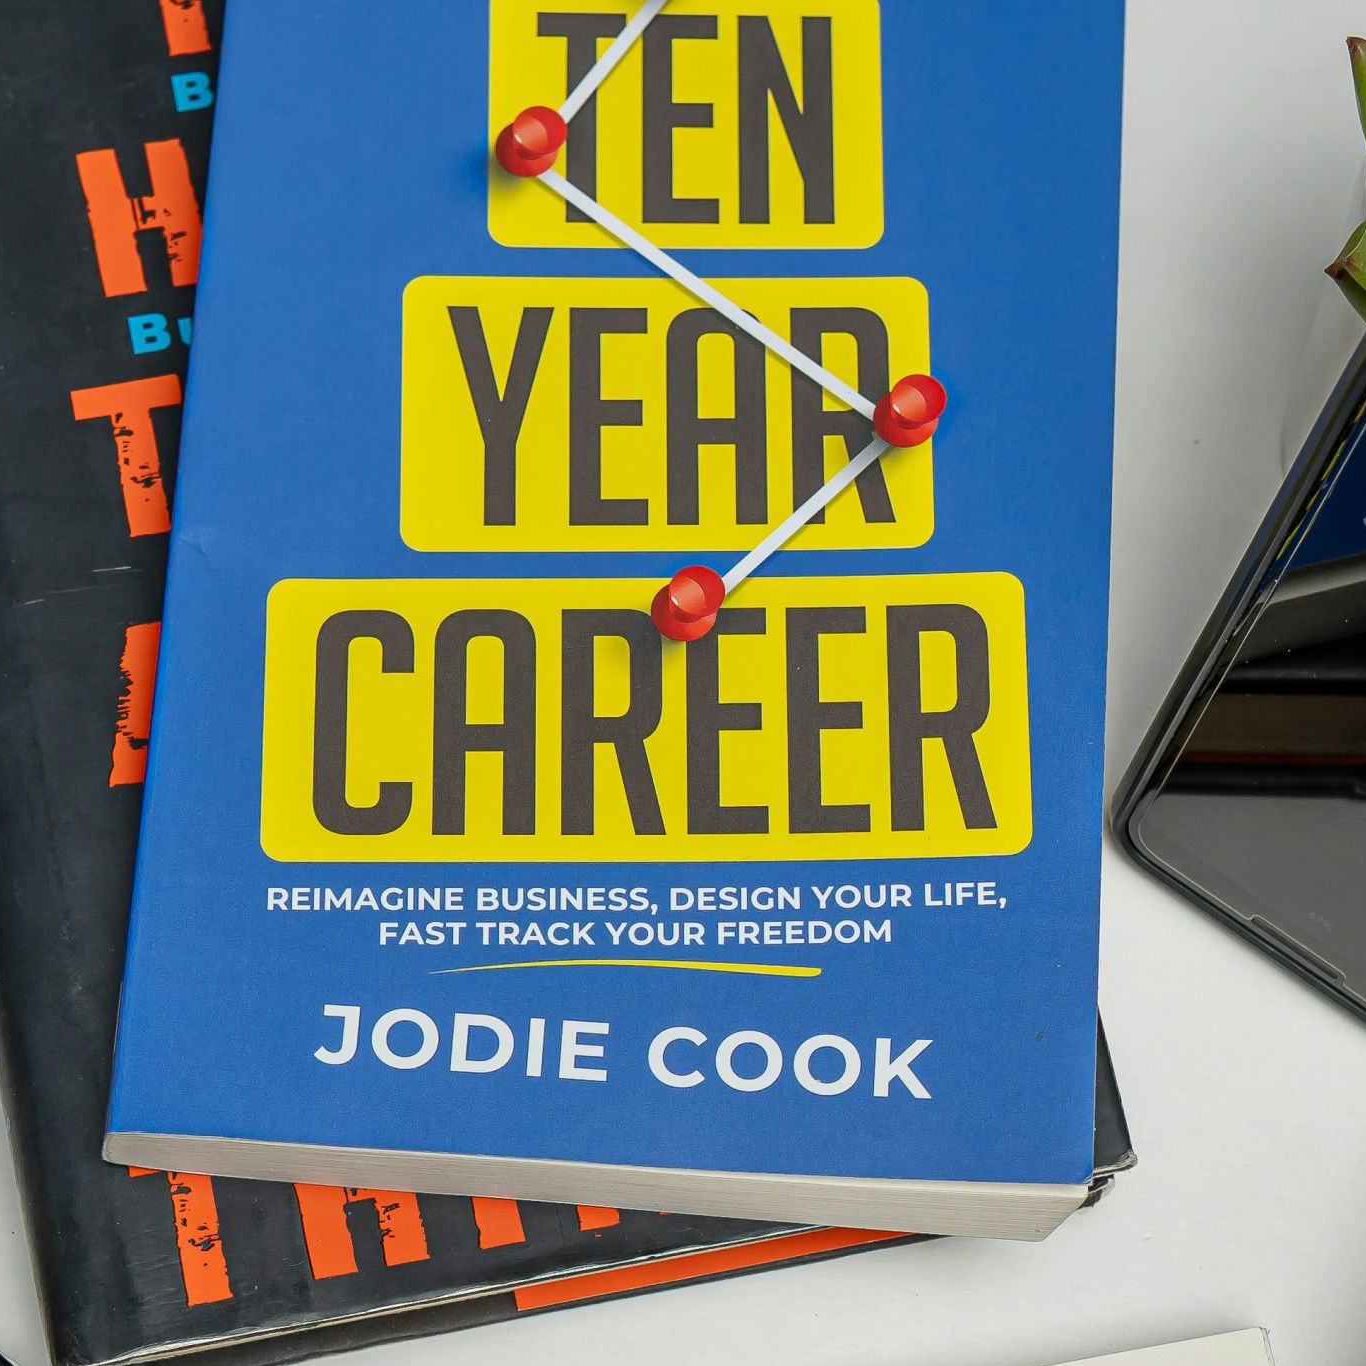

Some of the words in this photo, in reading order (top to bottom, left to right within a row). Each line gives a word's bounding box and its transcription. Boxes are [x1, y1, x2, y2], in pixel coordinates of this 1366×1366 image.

[537, 11, 836, 225] TEN
[447, 305, 897, 526] YEAR
[311, 602, 999, 837] CAREER
[268, 887, 463, 910] REIMAGINE
[477, 888, 658, 915] BUSINESS,
[671, 887, 800, 910] DESIGN
[811, 884, 911, 908] YOUR
[925, 882, 1006, 908] LIFE,
[380, 922, 466, 945] FAST
[476, 922, 595, 945] TRACK
[605, 923, 705, 945] YOUR
[718, 920, 891, 944] FREEDOM
[314, 1005, 609, 1081] JODIE
[648, 1027, 933, 1098] COOK
